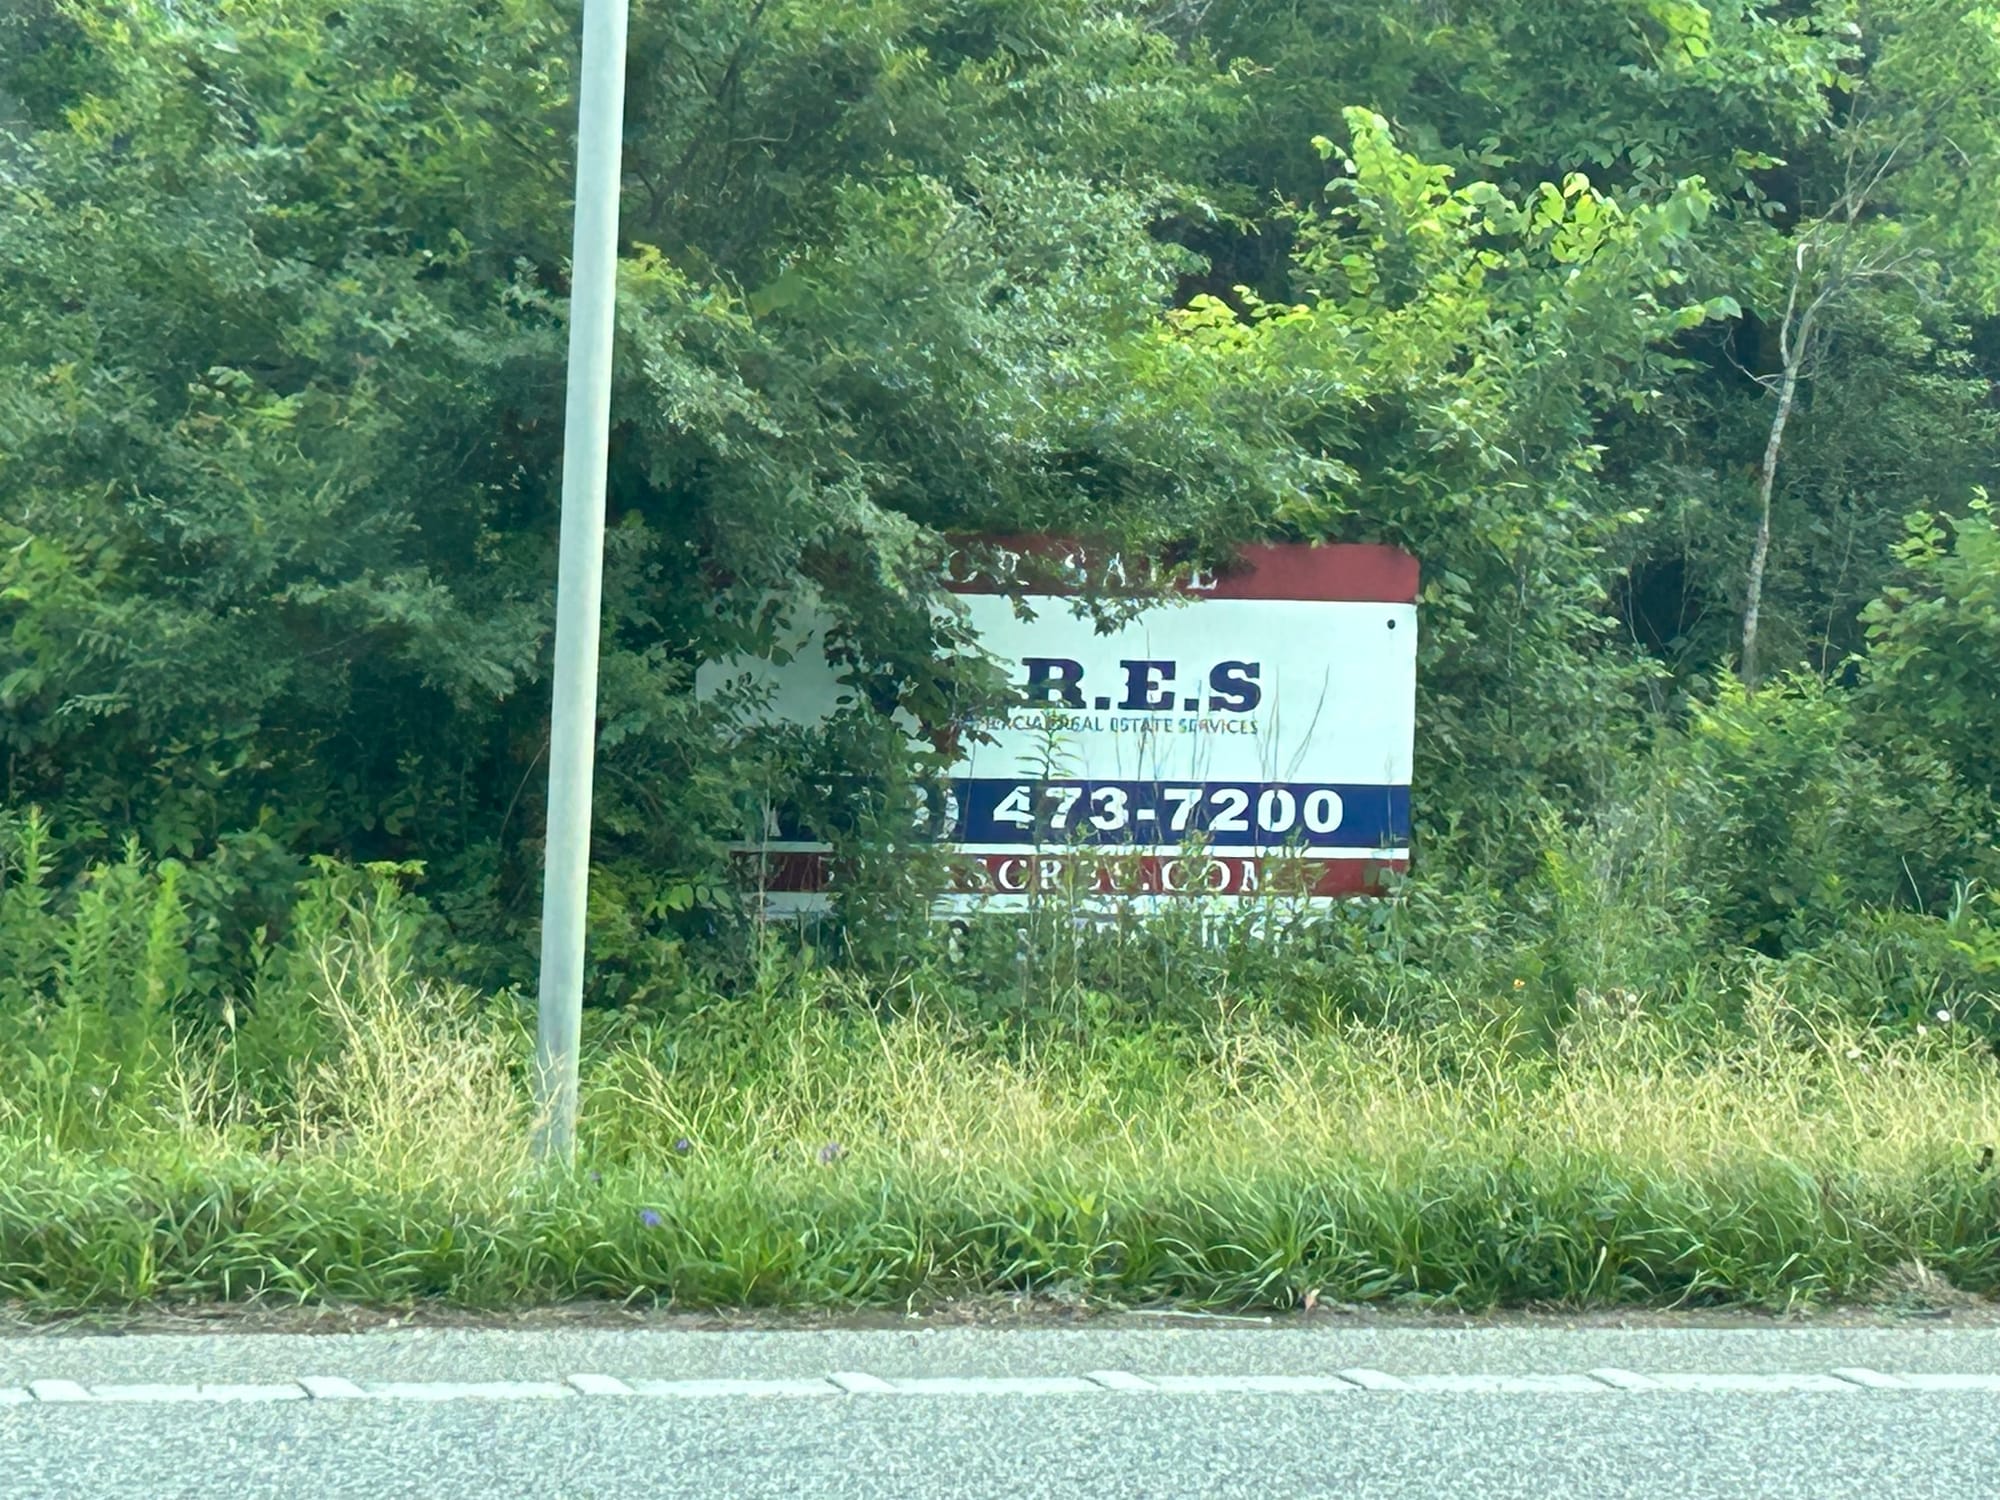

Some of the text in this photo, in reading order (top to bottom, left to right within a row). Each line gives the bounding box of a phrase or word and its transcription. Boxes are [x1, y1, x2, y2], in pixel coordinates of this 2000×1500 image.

[1110, 717, 1174, 734] ESTATE
[1178, 718, 1259, 735] SERVICES
[993, 785, 1344, 833] 473-7200
